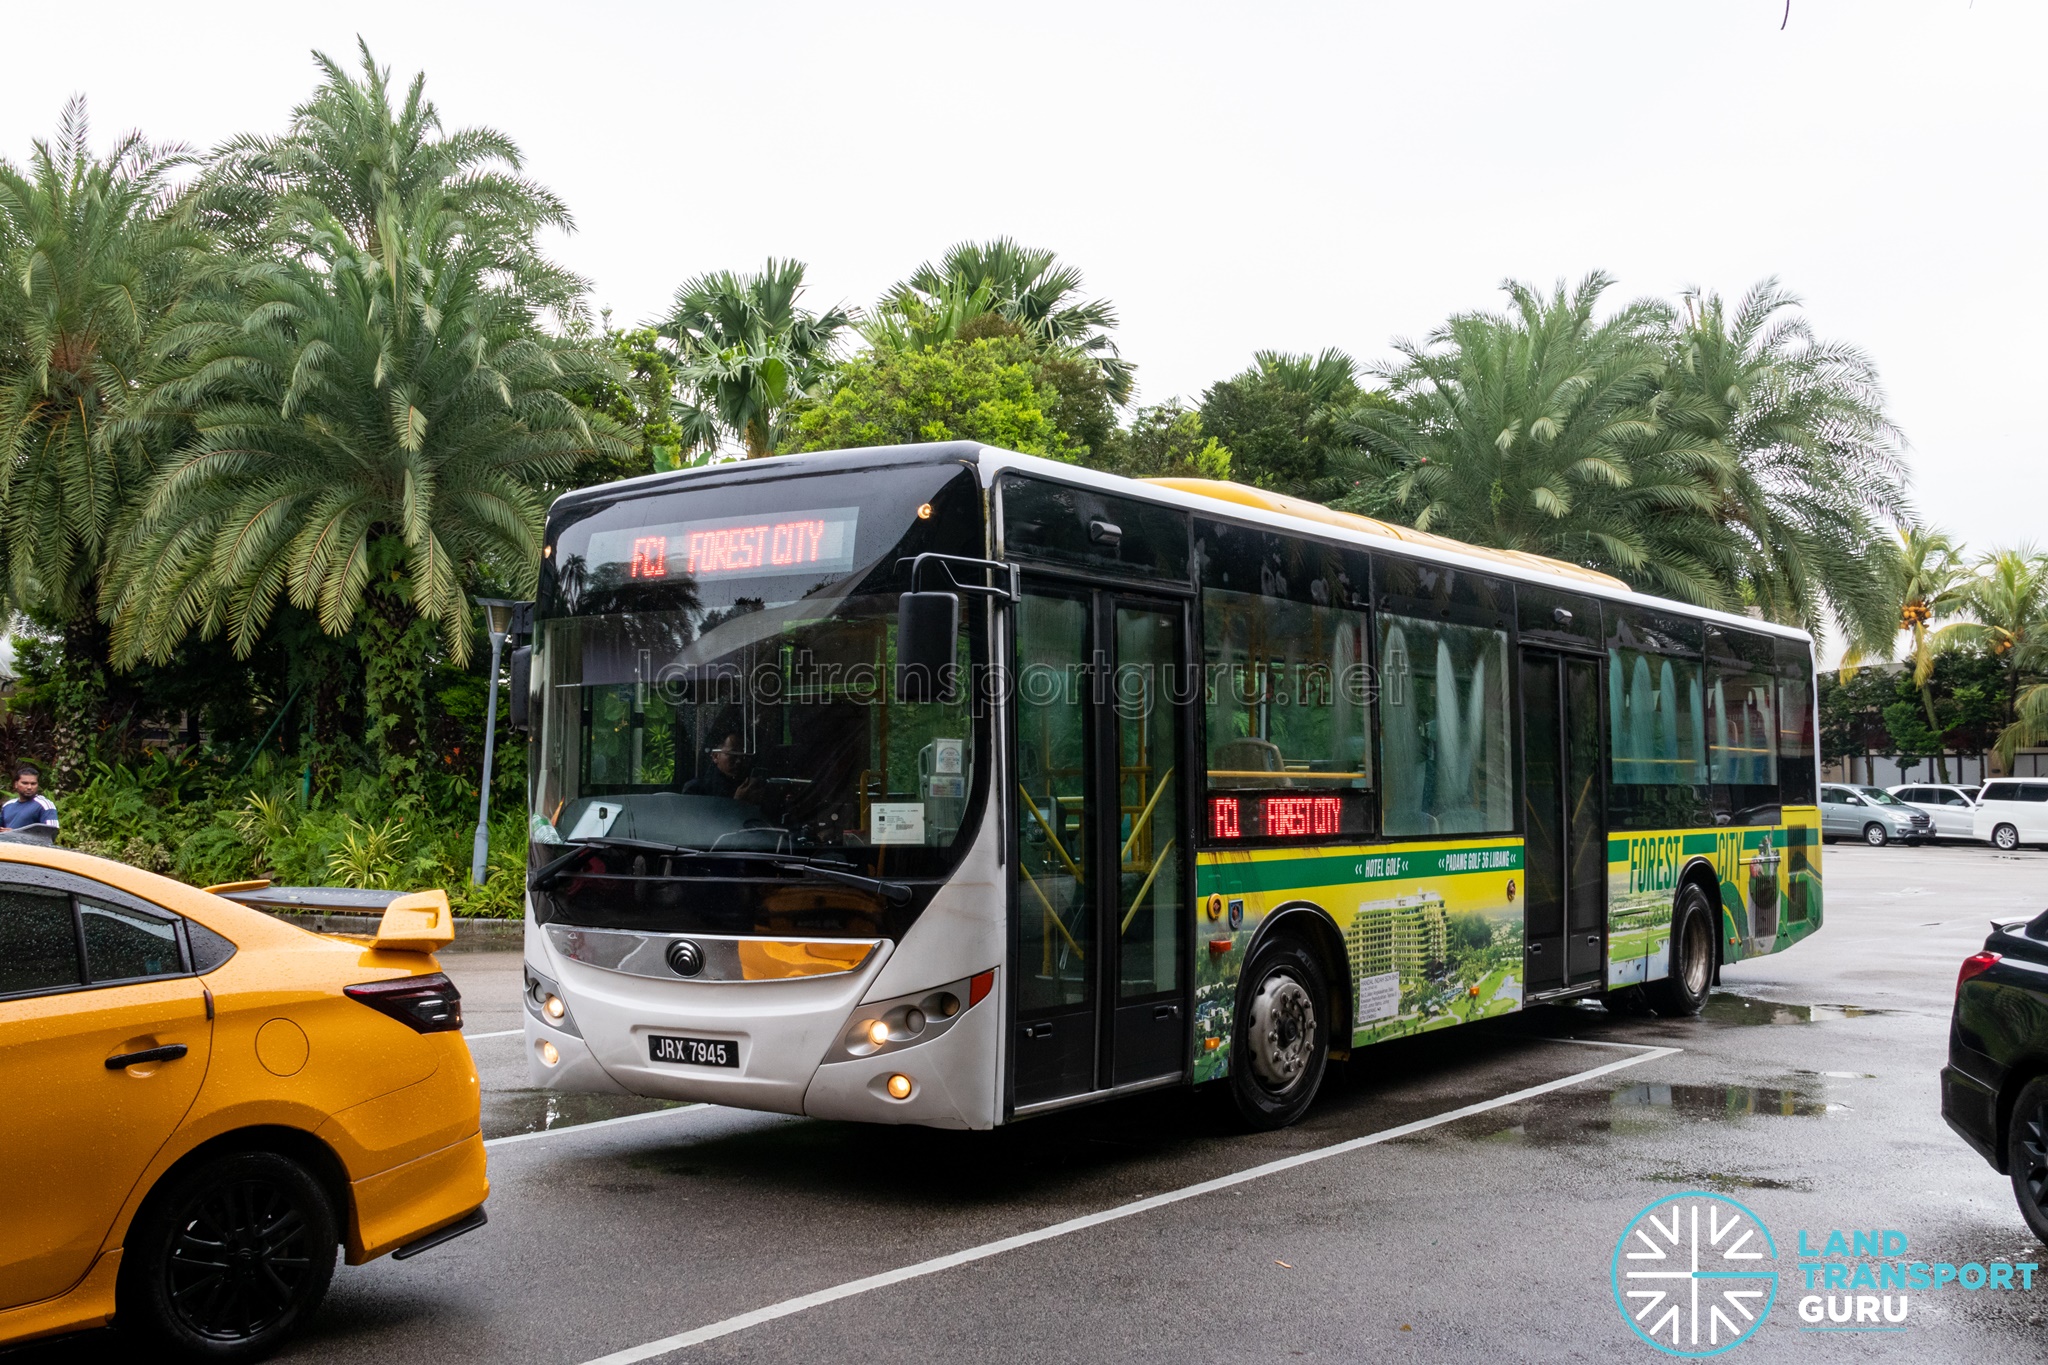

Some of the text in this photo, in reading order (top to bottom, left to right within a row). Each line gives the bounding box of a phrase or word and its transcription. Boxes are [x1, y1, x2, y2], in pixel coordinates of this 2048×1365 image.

[630, 520, 824, 578] FC1 FOREST CITY
[1216, 798, 1340, 837] FC1 FOREST CITY
[1365, 857, 1401, 878] HOTEL GOLF
[1445, 850, 1510, 872] PADANG GOLF 36 LUBANG
[1629, 831, 1743, 894] FOREST CITY
[656, 1039, 727, 1064] JRX 7945
